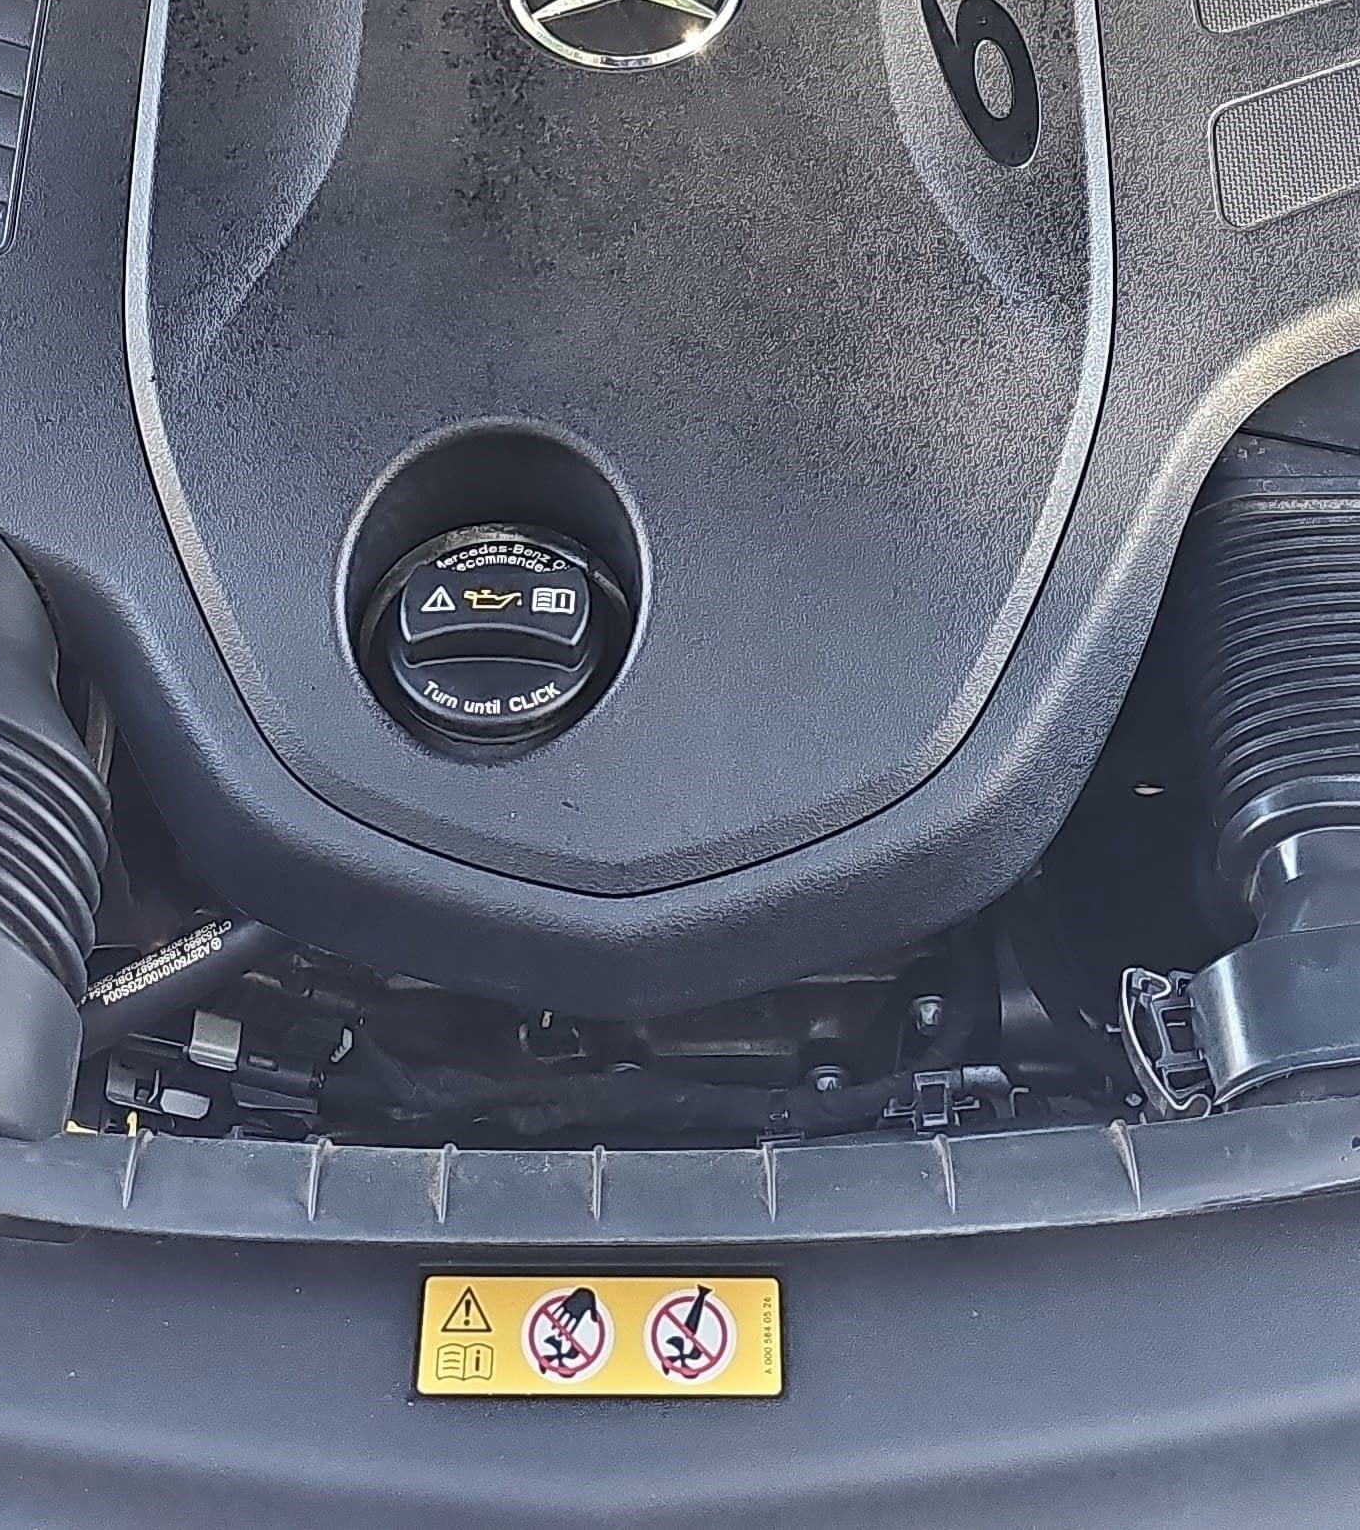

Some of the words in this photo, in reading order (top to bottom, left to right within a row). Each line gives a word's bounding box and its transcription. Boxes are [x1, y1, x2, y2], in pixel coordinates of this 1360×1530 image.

[451, 554, 554, 573] ecommende
[423, 680, 458, 709] Turn
[463, 700, 501, 715] until
[509, 682, 562, 712] CLICK
[763, 1297, 771, 1308] 26
[763, 1311, 772, 1323] 05
[763, 1326, 772, 1344] 584
[764, 1347, 772, 1366] 000
